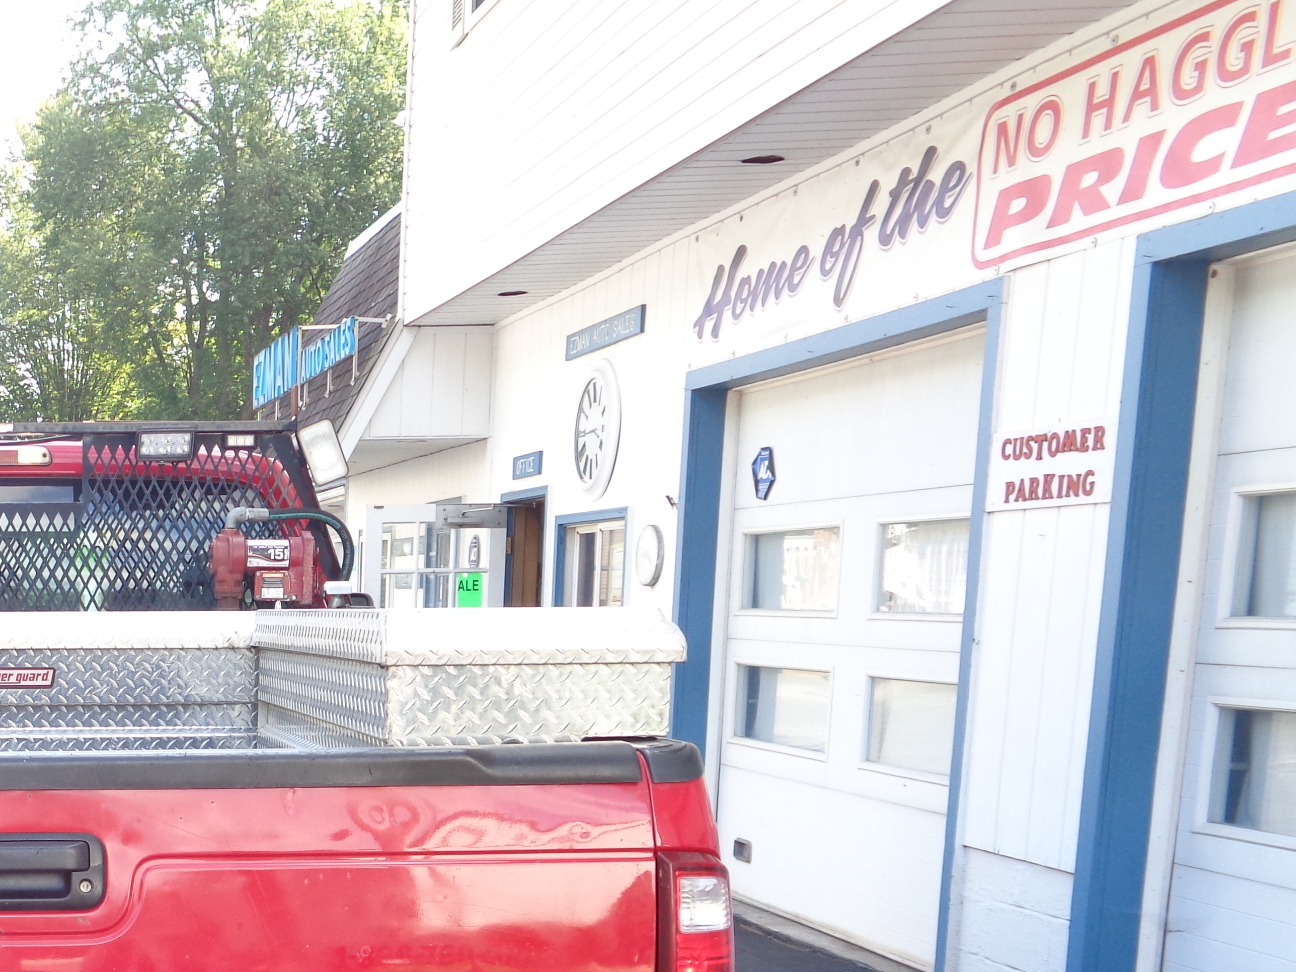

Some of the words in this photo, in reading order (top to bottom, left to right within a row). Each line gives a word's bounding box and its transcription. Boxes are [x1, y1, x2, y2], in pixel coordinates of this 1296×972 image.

[991, 94, 1063, 177] NO
[983, 78, 1296, 250] PRICE
[694, 244, 815, 340] Home
[820, 179, 877, 308] of
[878, 145, 973, 248] the
[570, 332, 590, 355] EZMAN
[593, 323, 610, 344] AUTO
[612, 313, 636, 338] SALES
[254, 330, 294, 408] EZMAN
[301, 339, 323, 384] AUTO
[324, 322, 352, 371] SALES
[1001, 425, 1106, 461] CUSTOMER
[515, 456, 536, 476] OFFICE
[1003, 469, 1095, 504] PARKING
[15, 671, 49, 684] guard
